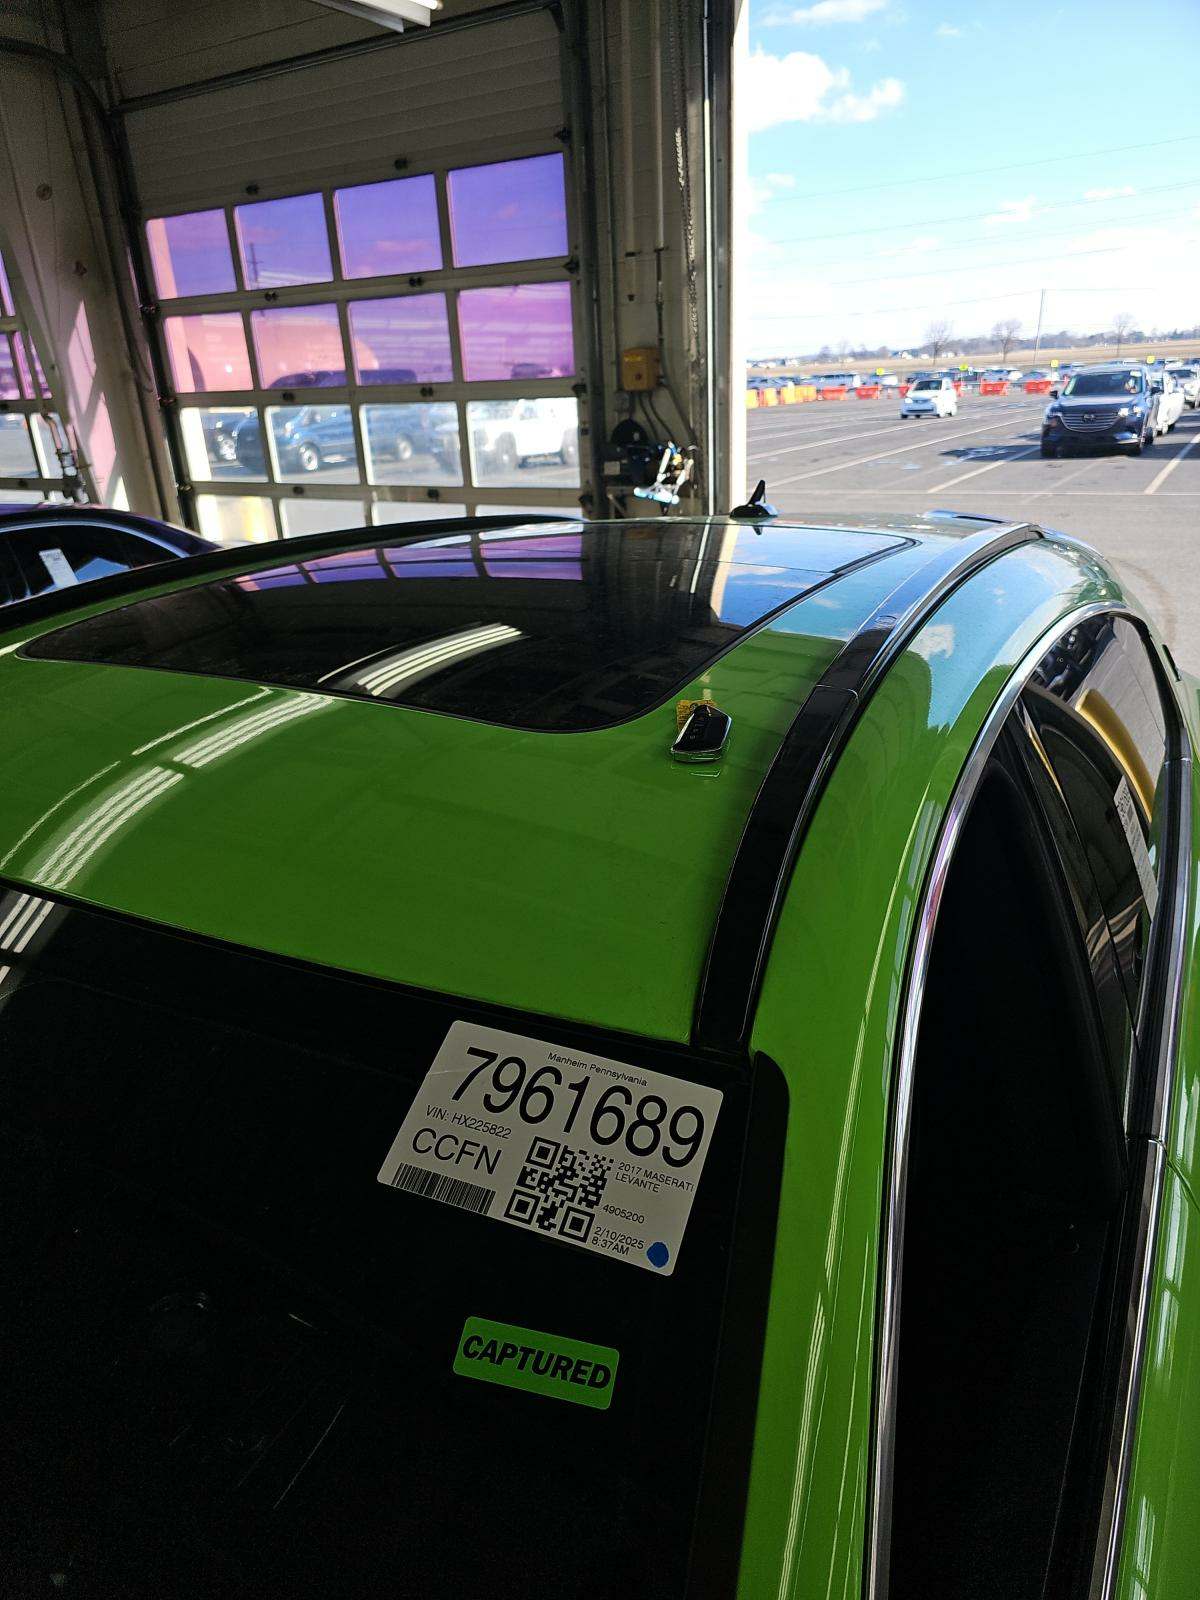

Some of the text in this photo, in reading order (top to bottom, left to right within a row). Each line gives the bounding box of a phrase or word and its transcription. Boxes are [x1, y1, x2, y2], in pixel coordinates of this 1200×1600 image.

[547, 1052, 648, 1087] Manheim Pennsylvania
[426, 1104, 512, 1139] VIN: HX225822
[451, 1046, 705, 1168] 7961689
[412, 1127, 502, 1175] CCFN
[615, 1171, 661, 1193] LEVANTE
[618, 1161, 695, 1193] 2017 MASERATI
[602, 1203, 645, 1224] 4905200
[591, 1236, 630, 1256] 8:37AM
[594, 1226, 645, 1250] 2/10/2025
[462, 1334, 612, 1389] CAPTURED
